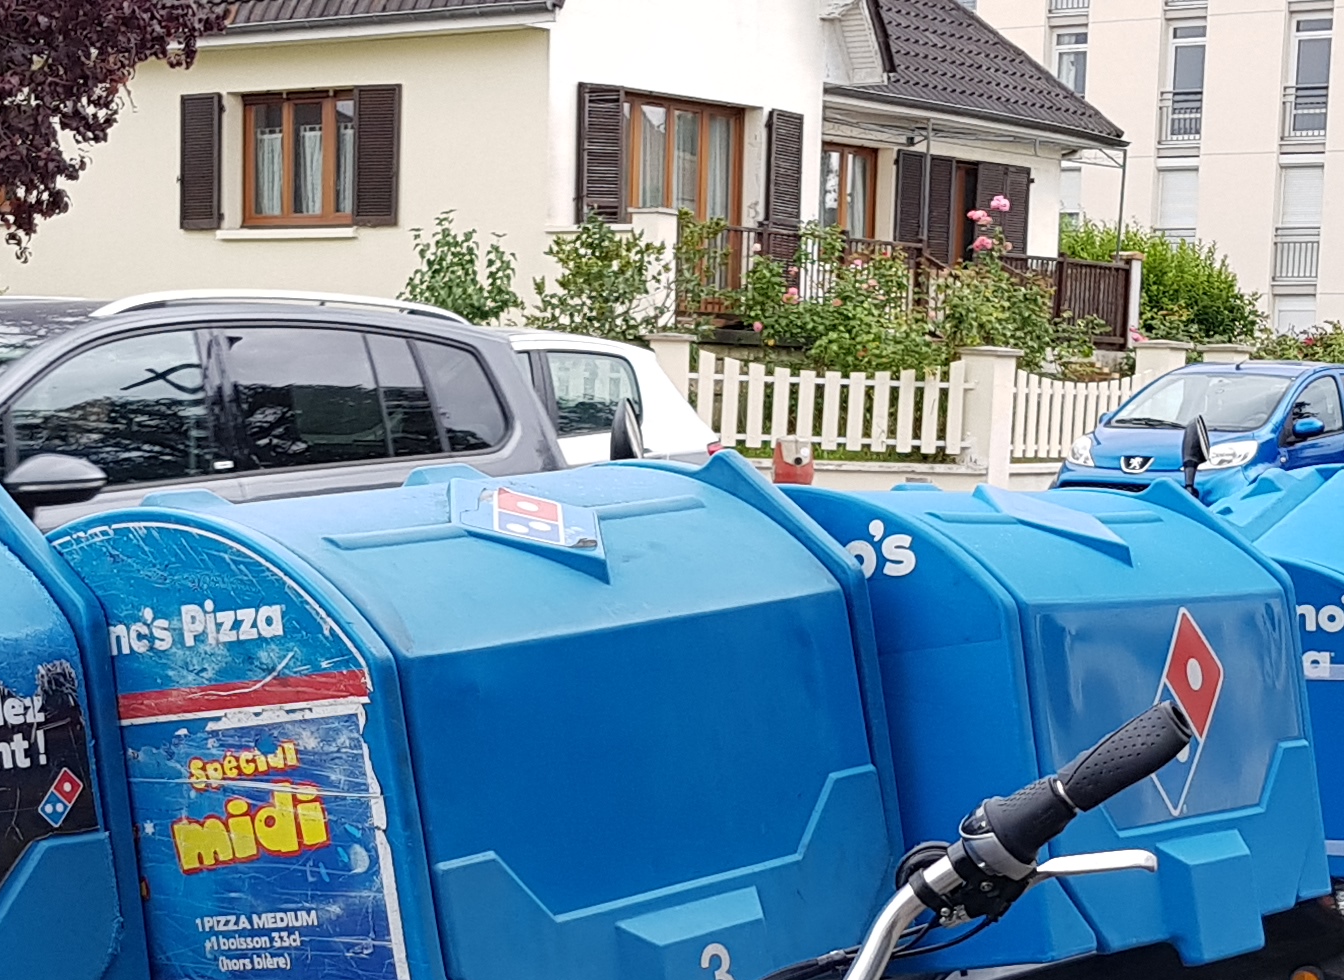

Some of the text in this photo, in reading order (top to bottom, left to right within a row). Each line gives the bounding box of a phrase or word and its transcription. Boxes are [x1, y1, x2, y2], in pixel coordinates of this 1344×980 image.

[181, 598, 284, 648] Pizza
[173, 781, 331, 872] midi
[205, 914, 251, 932] PIZZA
[253, 910, 318, 929] MEDIUM
[220, 934, 270, 951] boisson
[219, 956, 252, 972] (hors
